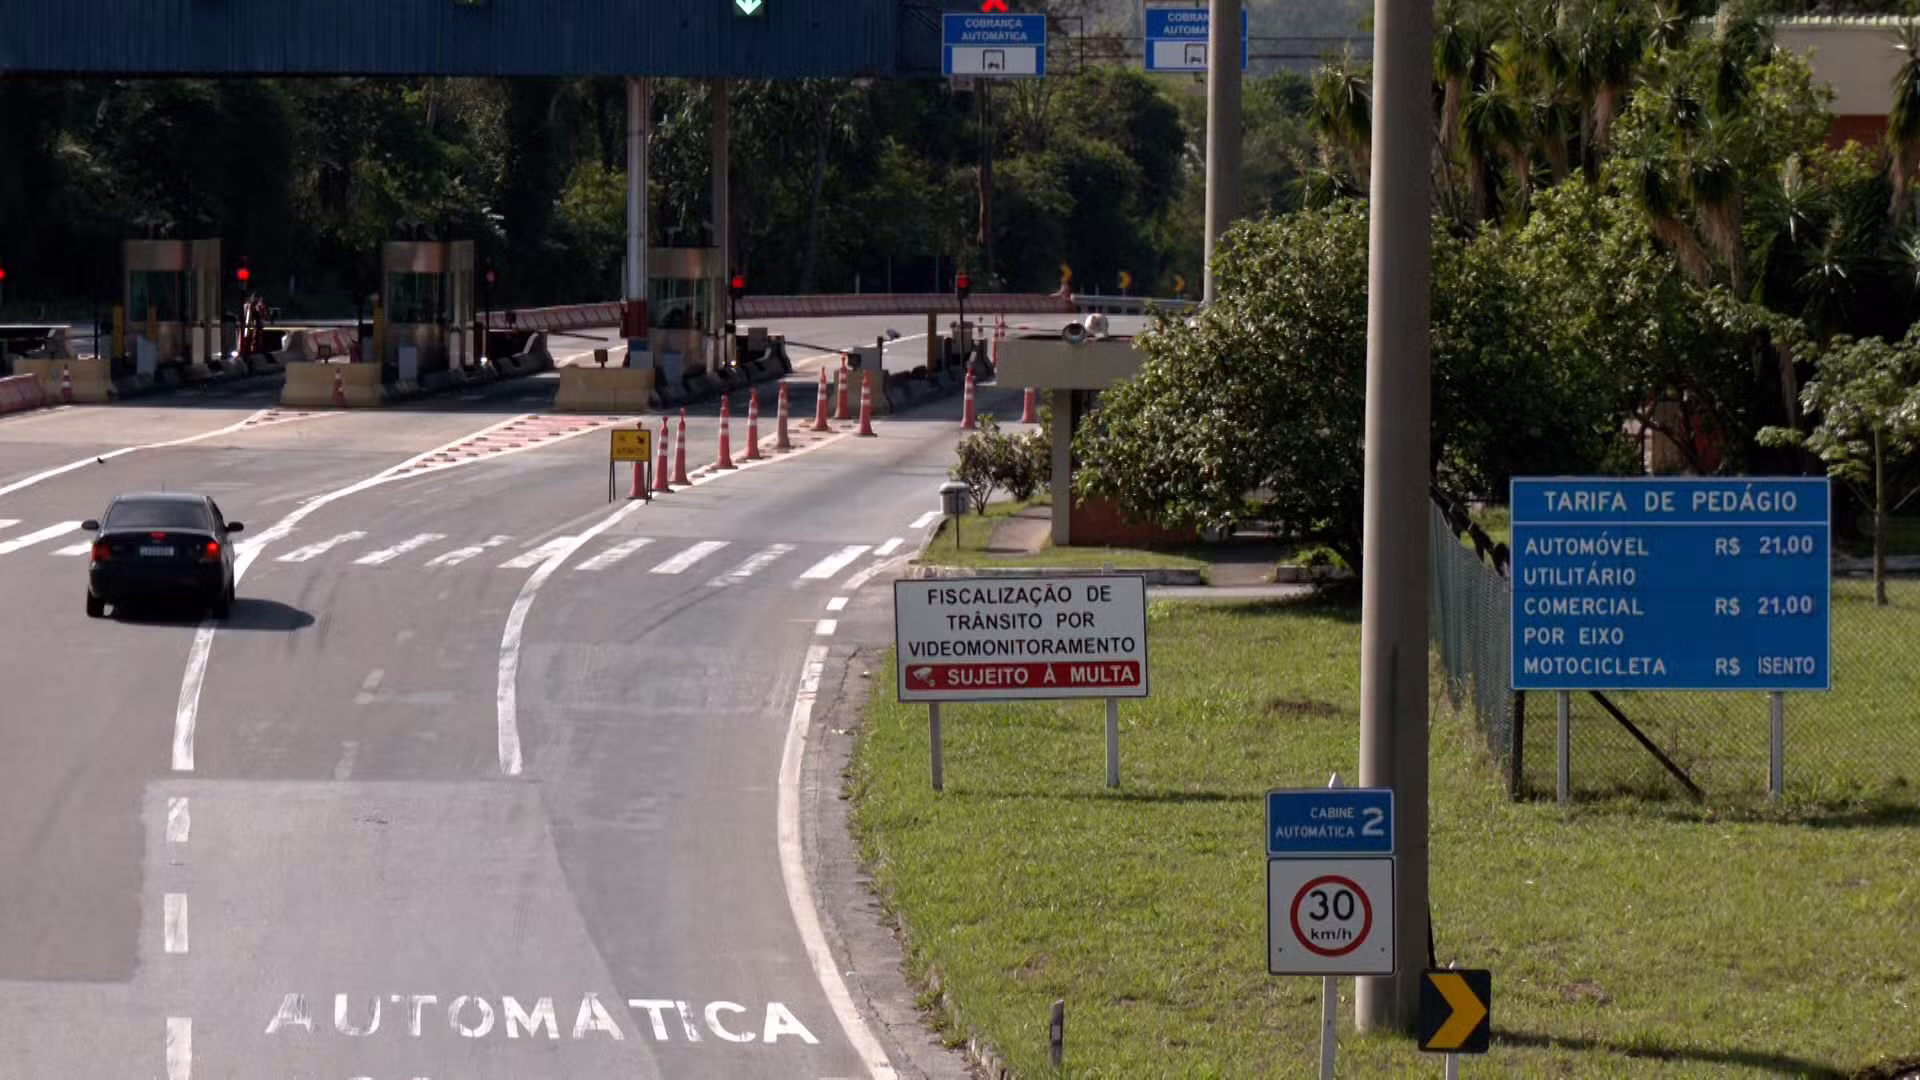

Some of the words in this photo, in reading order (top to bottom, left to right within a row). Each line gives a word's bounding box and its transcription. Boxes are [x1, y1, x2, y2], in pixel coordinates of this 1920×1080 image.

[964, 18, 1022, 30] COBRANÇA
[1167, 13, 1208, 22] COBRAN
[961, 30, 1028, 41] AUTOMÁTICA
[1544, 491, 1627, 512] TARIFA
[1644, 491, 1675, 512] DE
[1692, 484, 1797, 512] PEDÁGIO
[1524, 532, 1649, 556] AUTOMÓVEL
[1715, 537, 1741, 556] R$
[1759, 536, 1814, 556] 21,00
[1524, 561, 1636, 586] UTILITÁRIO
[927, 584, 1072, 607] FISCALIZAÇÃO
[1086, 585, 1112, 602] DE
[1524, 597, 1645, 616] COMERCIAL
[1715, 597, 1741, 616] R$
[1758, 596, 1813, 616] 21,00
[946, 611, 1042, 630] TRÂNSITO
[1056, 612, 1095, 628] POR
[1524, 627, 1564, 645] POR
[1579, 627, 1624, 645] EIXO
[909, 637, 1135, 657] VIDEOMONITORAMENTO
[947, 667, 1029, 685] SUJEITO
[1043, 663, 1056, 684] À
[1070, 665, 1135, 683] MULTA
[1524, 657, 1667, 675] MOTOCICLETA
[1715, 657, 1741, 676] R$
[1758, 656, 1815, 675] ISENTO
[1310, 807, 1355, 818] CABINE
[1361, 807, 1385, 836] 2
[1275, 824, 1355, 838] AUTOMÁTICA
[1309, 889, 1355, 921] 30
[1311, 928, 1352, 940] km/h
